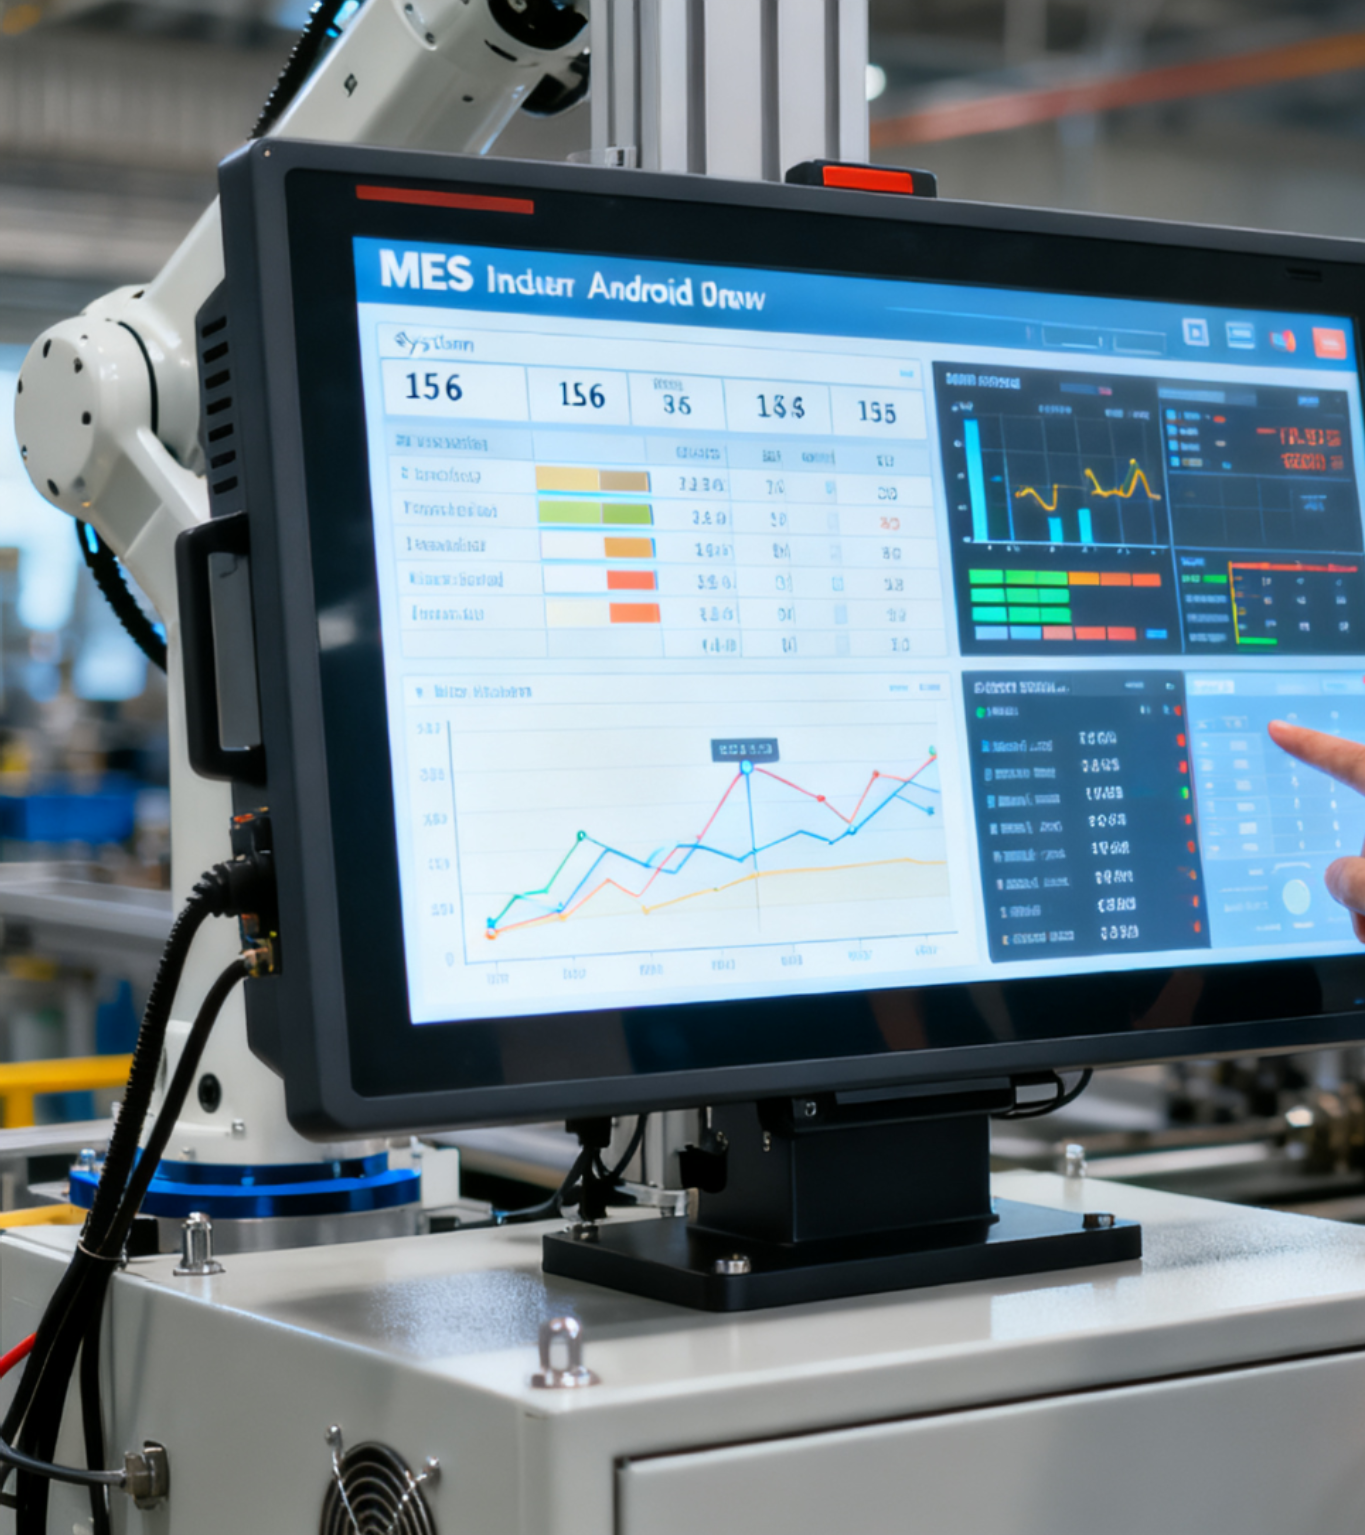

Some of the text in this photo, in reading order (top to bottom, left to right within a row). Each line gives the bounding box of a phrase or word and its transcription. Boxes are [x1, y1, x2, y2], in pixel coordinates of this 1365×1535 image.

[379, 248, 474, 292] MES
[587, 271, 694, 306] Android
[405, 372, 463, 402] 156
[559, 381, 606, 409] 156
